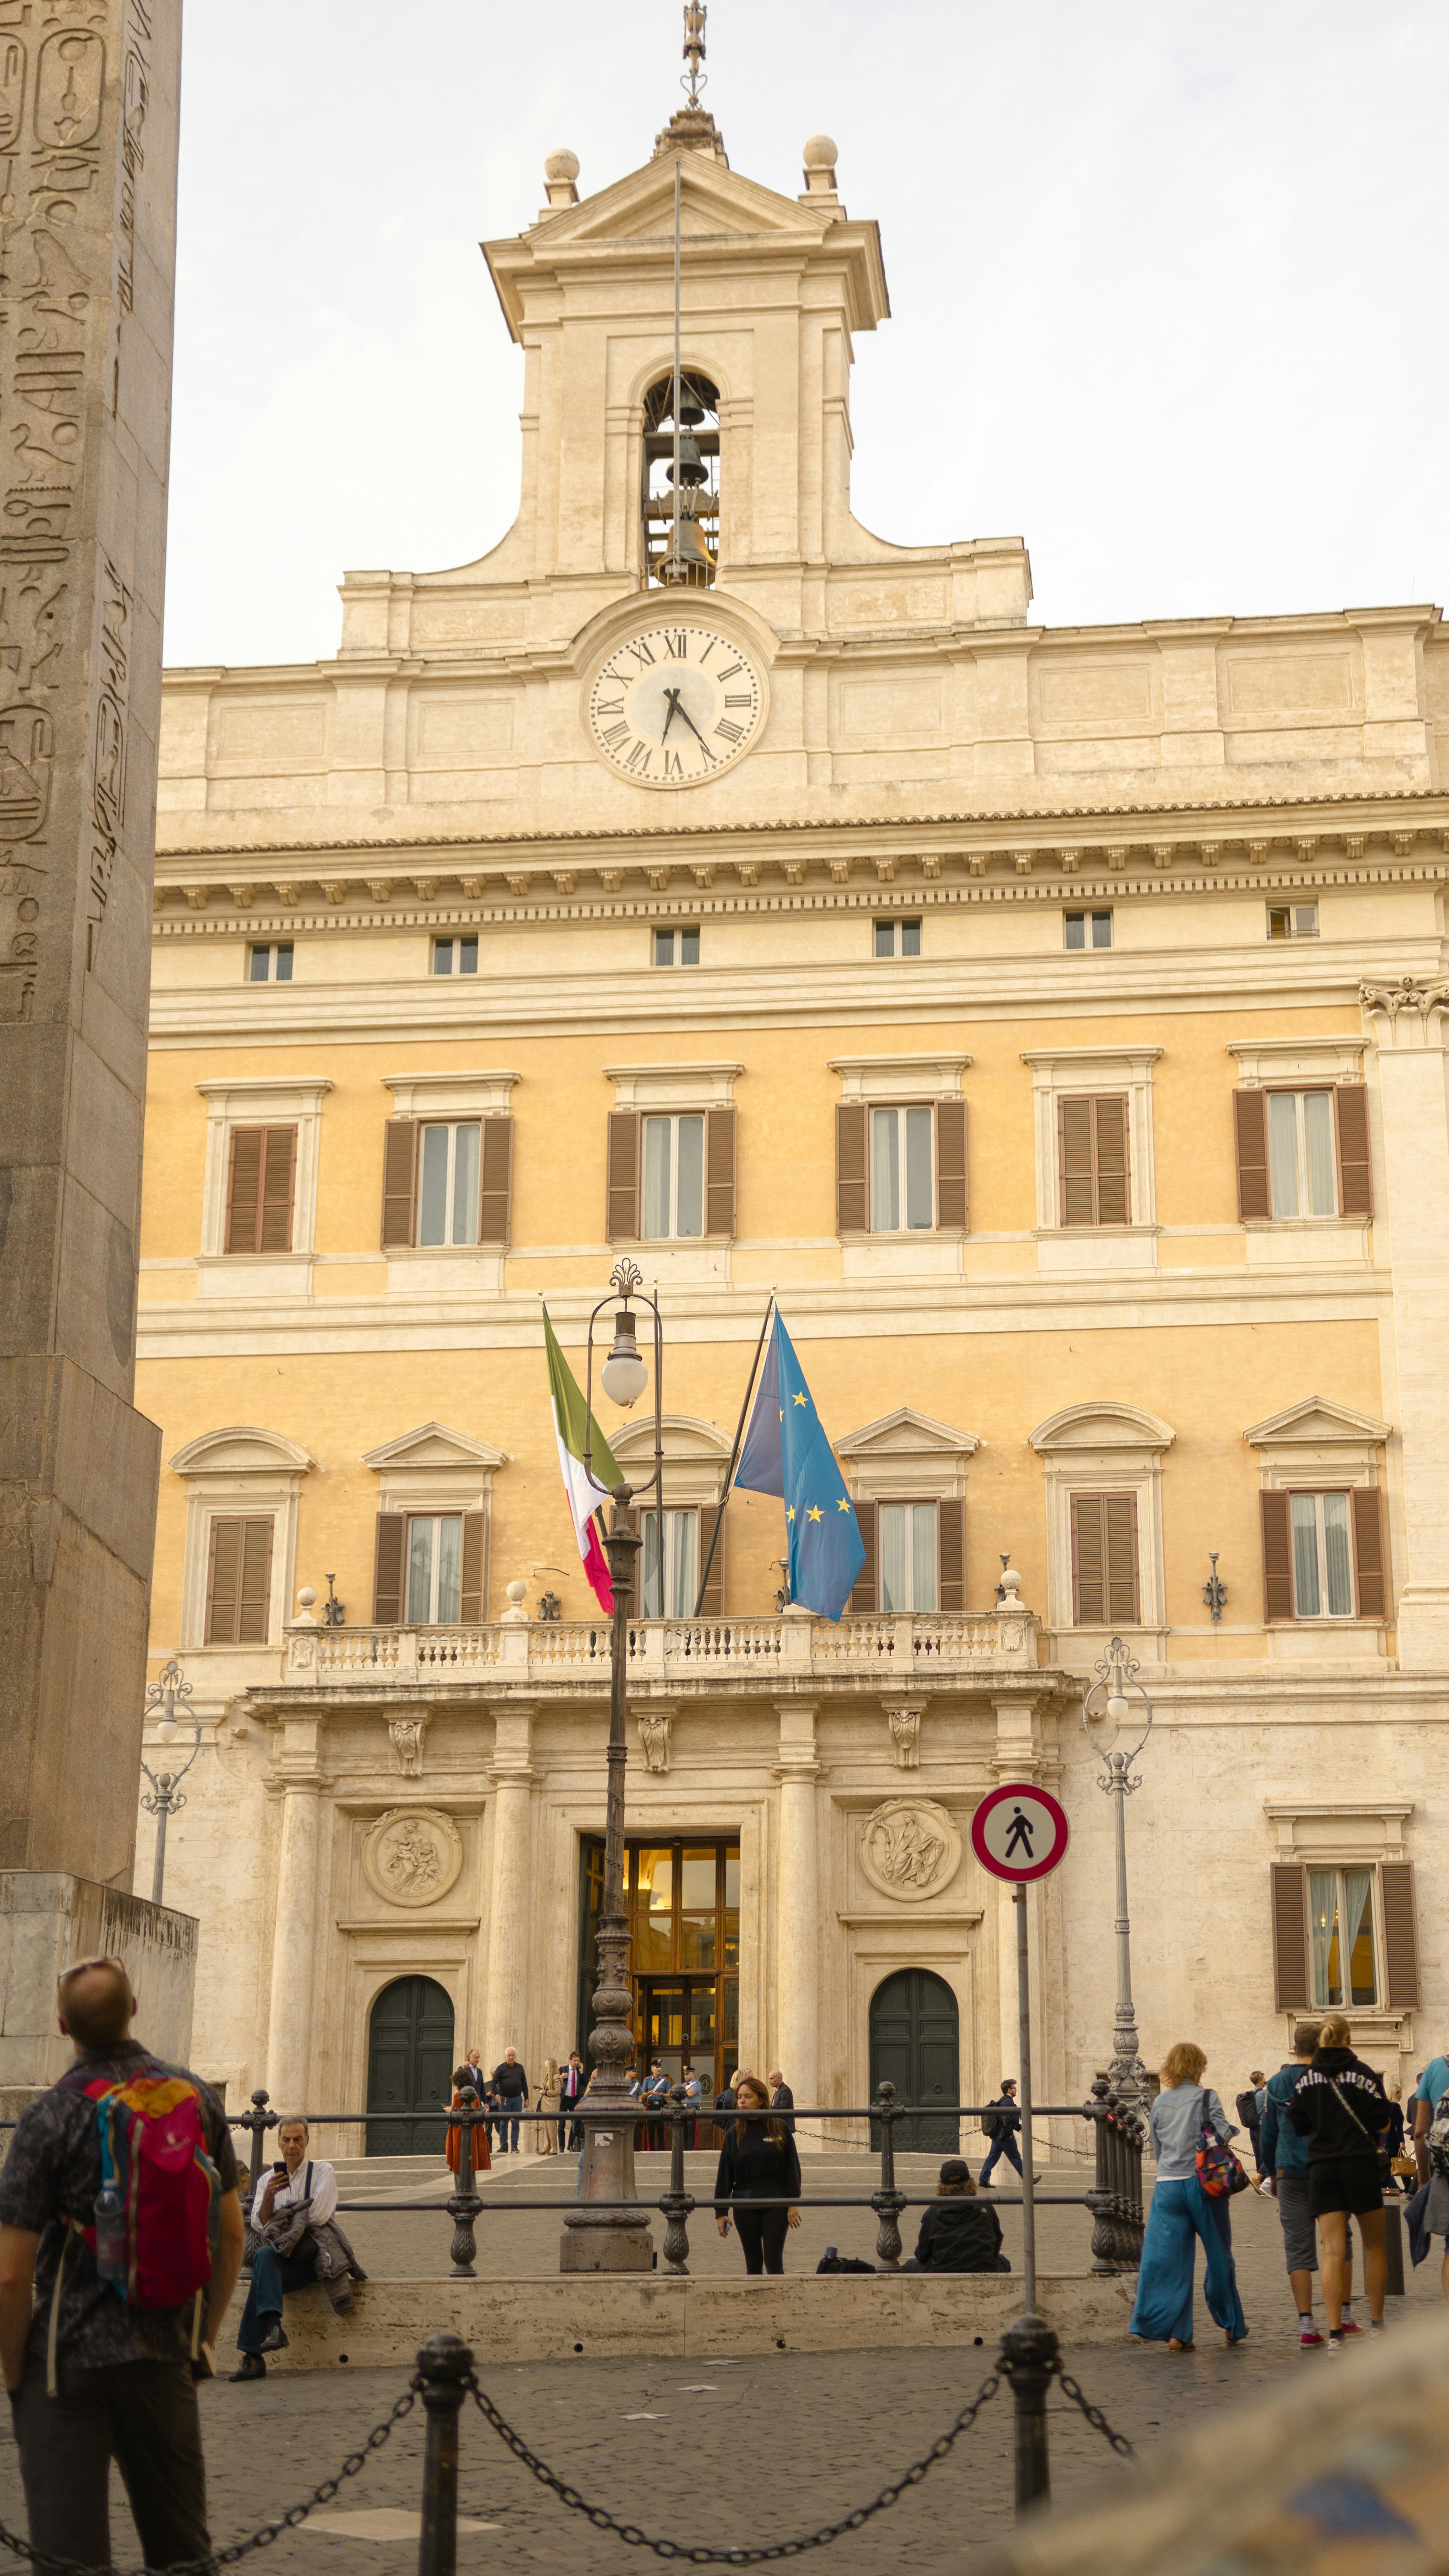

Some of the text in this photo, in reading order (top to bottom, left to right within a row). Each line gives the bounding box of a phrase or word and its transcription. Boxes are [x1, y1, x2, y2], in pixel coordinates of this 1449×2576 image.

[628, 641, 657, 671] XI
[663, 634, 687, 659] XII
[699, 641, 715, 664] I
[605, 667, 635, 689] X
[716, 662, 743, 682] II
[597, 696, 625, 715] IX
[724, 694, 751, 708] III
[601, 719, 633, 753] VIII
[713, 717, 745, 743] IIII
[626, 740, 653, 771] VII
[664, 750, 684, 775] VI
[699, 743, 718, 768] V
[0, 1489, 40, 1513] VS
